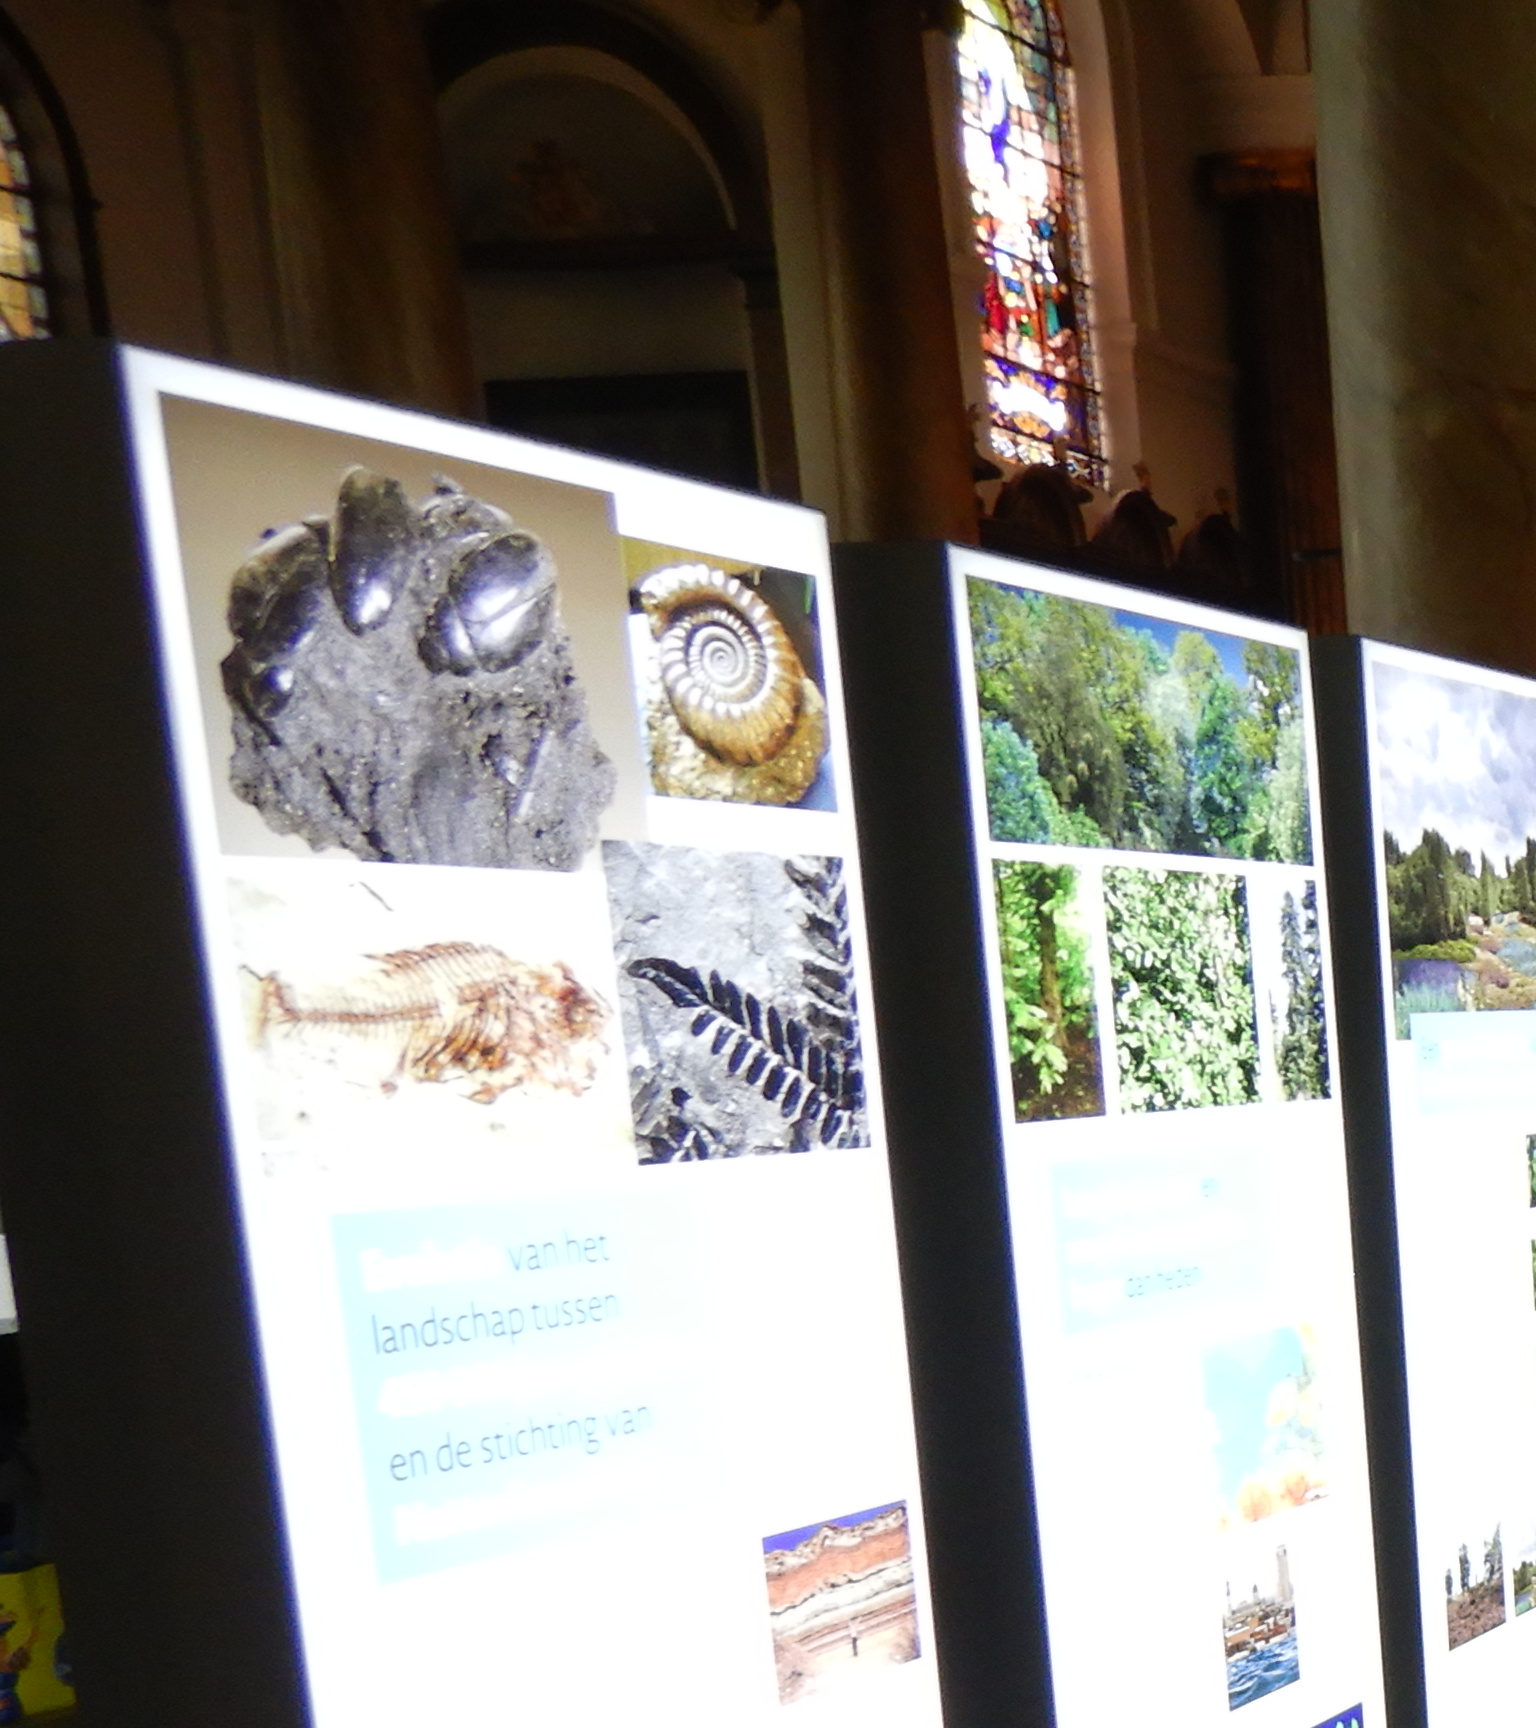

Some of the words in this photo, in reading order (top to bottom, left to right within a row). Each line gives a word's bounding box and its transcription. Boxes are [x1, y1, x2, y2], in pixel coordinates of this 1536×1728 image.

[507, 1242, 558, 1272] van
[563, 1226, 611, 1263] het
[371, 1301, 526, 1355] landschap
[530, 1292, 622, 1332] tussen
[390, 1446, 428, 1482] en
[436, 1432, 473, 1472] de
[481, 1410, 601, 1465] stichting
[605, 1403, 655, 1438] van
